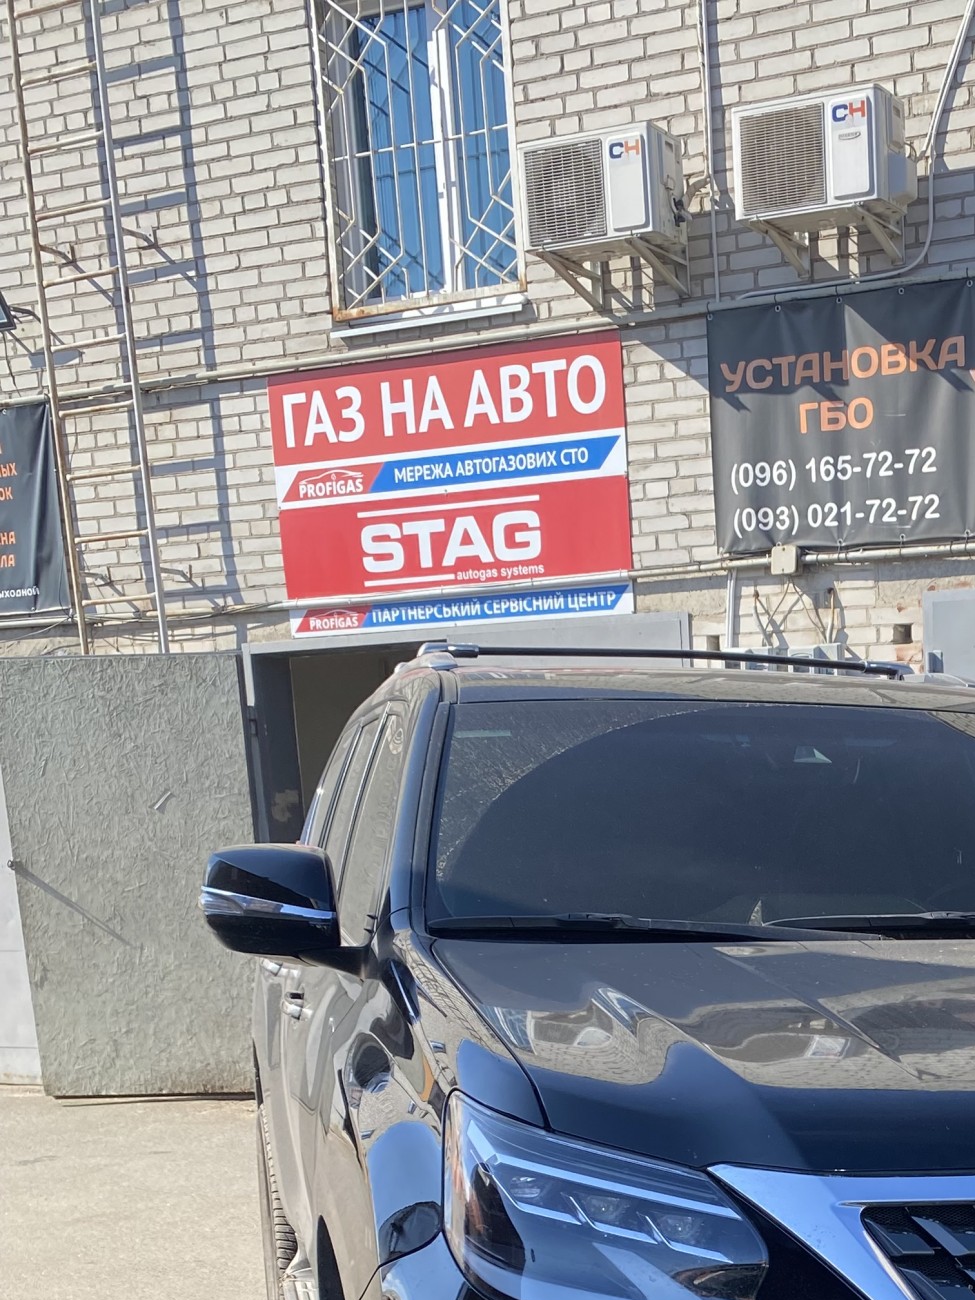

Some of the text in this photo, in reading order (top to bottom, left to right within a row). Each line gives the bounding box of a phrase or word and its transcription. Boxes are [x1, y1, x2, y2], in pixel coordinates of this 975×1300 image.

[832, 100, 865, 122] CH
[609, 139, 640, 159] CH
[720, 335, 966, 393] УСТАНОВКА
[282, 354, 606, 449] ГАЗ НА АВТО
[799, 396, 875, 434] ГБО
[0, 462, 18, 477] ЫХ
[394, 447, 589, 484] МЕРЕЖА АВТОГАЗОВИХ СТО
[731, 447, 937, 494] (096) 165-72-72
[298, 477, 364, 499] PROFIGAS
[733, 494, 940, 538] (093) 021-72-72
[360, 510, 542, 574] STAG
[456, 563, 545, 582] autogas systems
[309, 615, 359, 631] PROFIGAS
[372, 590, 617, 624] ПАРТНЕРСЬКИЙ СЕРВІСНИЙ ЦЕНТР
